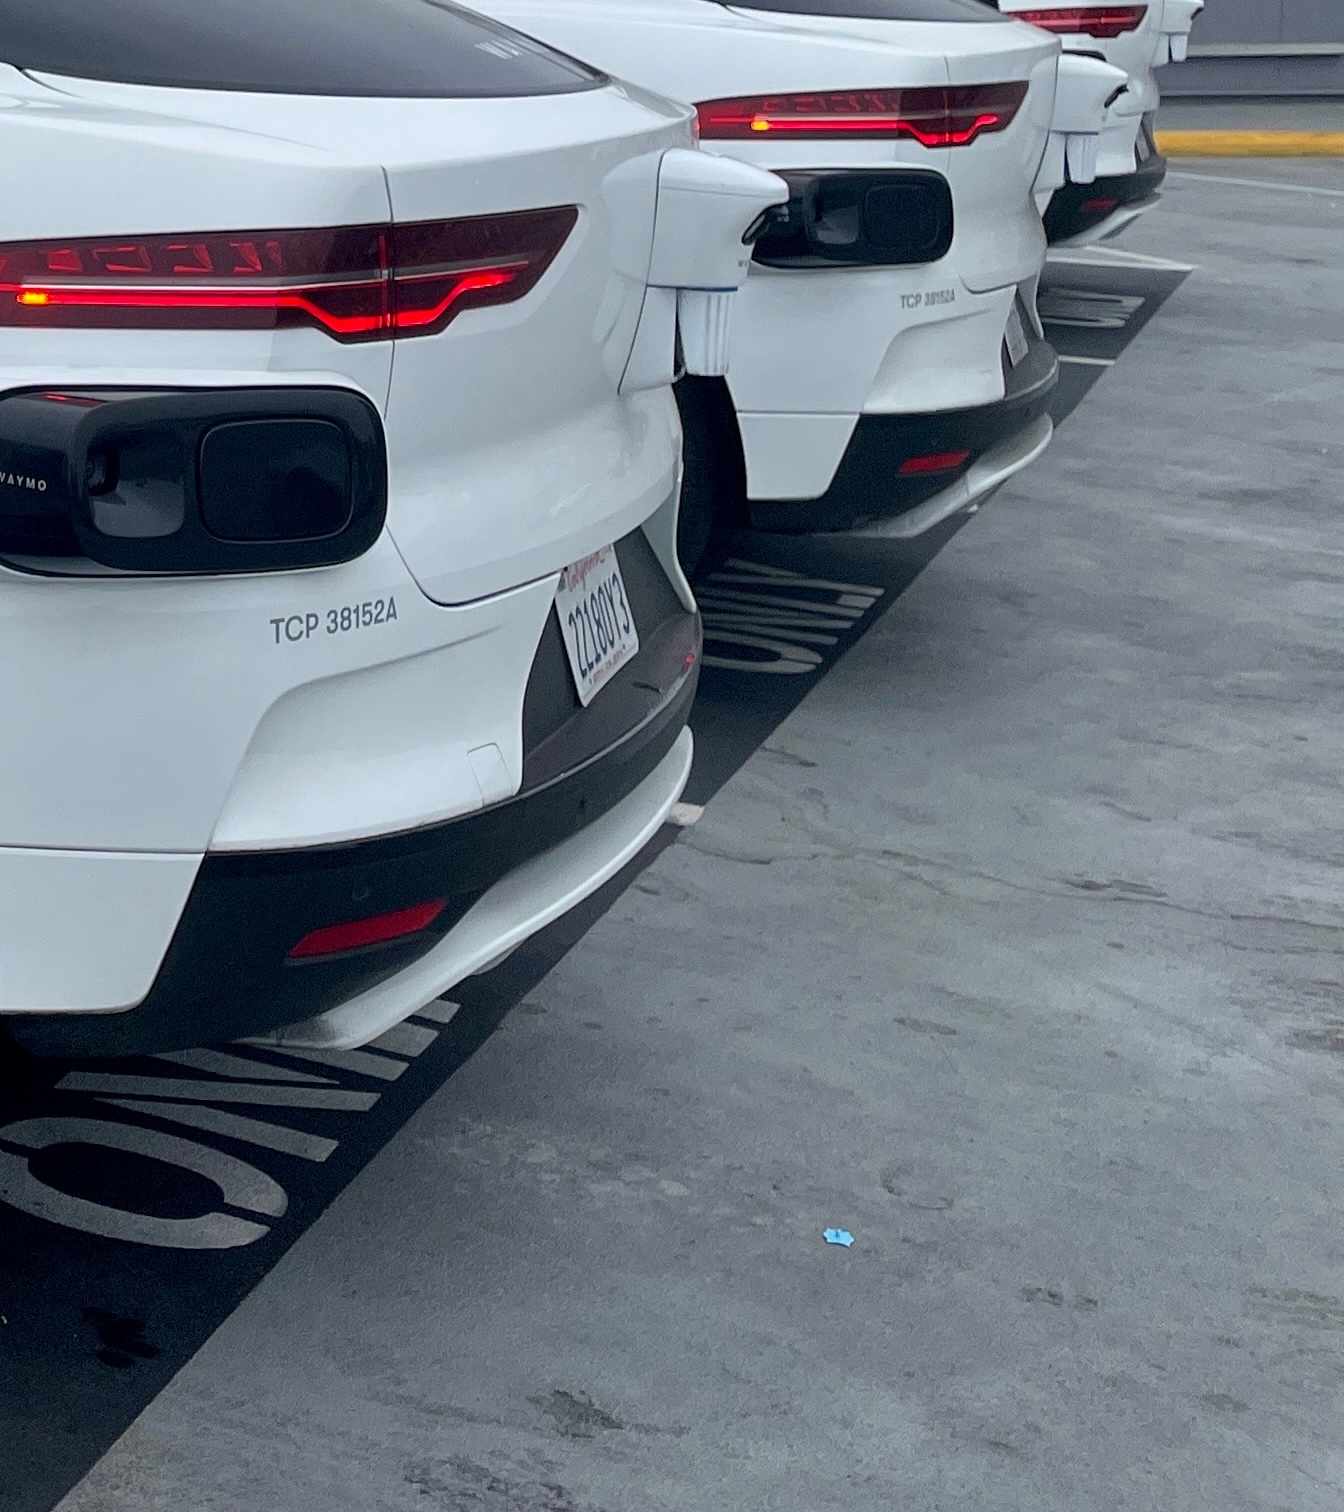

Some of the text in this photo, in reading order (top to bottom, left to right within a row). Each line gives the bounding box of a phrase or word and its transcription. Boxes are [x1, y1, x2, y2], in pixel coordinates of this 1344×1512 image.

[900, 292, 923, 309] TCP
[269, 595, 398, 645] TCP 38152A
